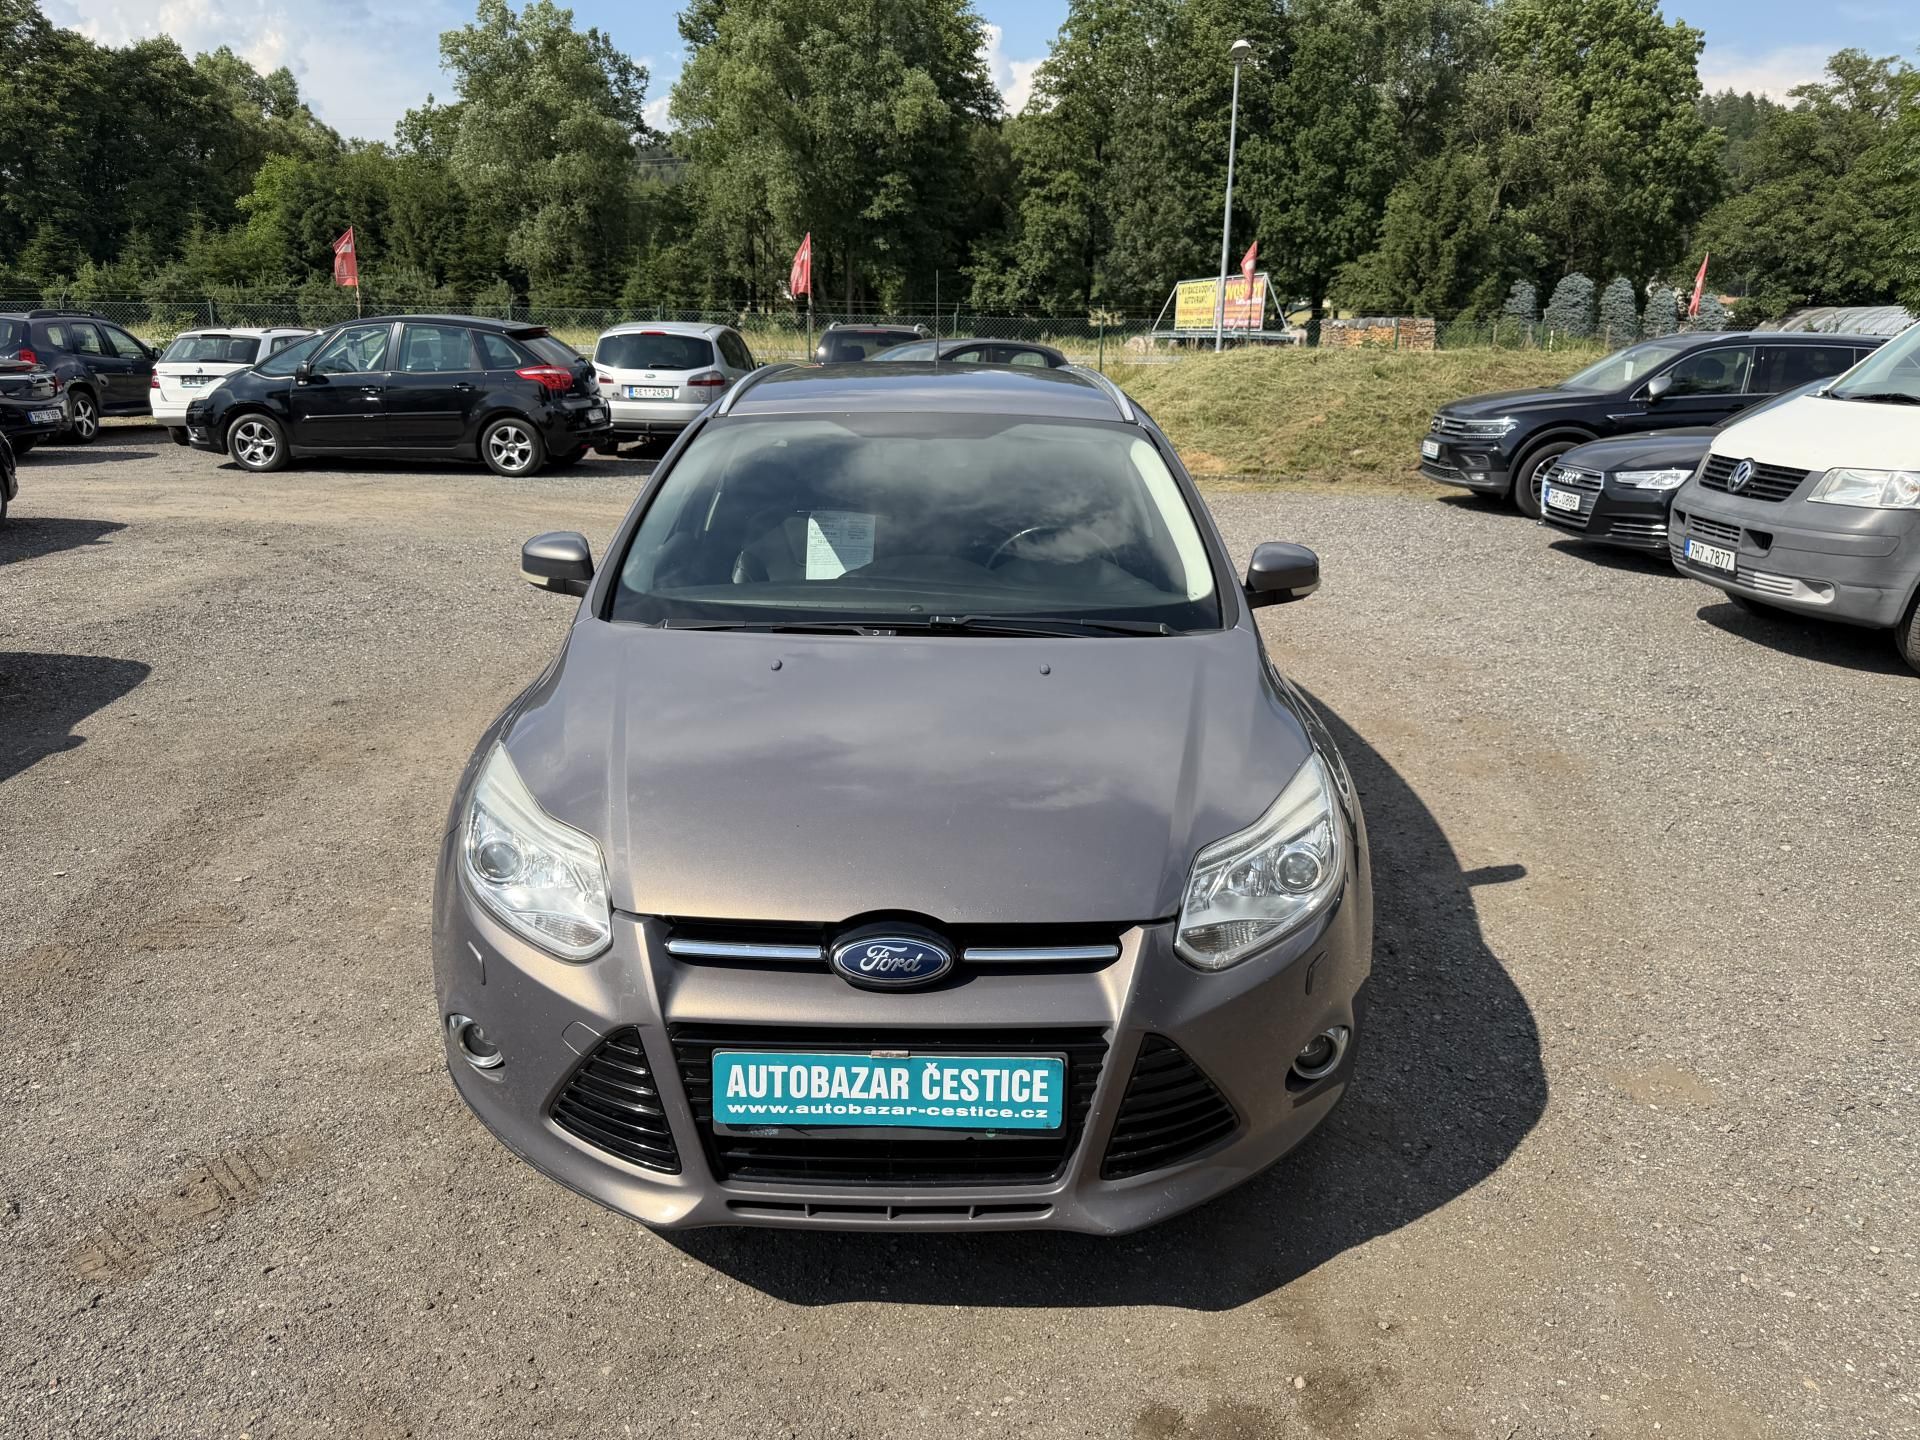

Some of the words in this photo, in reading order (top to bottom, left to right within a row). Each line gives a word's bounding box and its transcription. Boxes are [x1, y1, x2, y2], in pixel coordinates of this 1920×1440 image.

[1690, 542, 1705, 561] 7H7
[1709, 548, 1731, 569] 7877
[860, 945, 923, 972] Ford
[726, 1064, 909, 1100] AUTOBAZAR
[922, 1062, 1049, 1103] ČESTICE
[727, 1103, 1048, 1118] www.autobazar-cestice.cz
